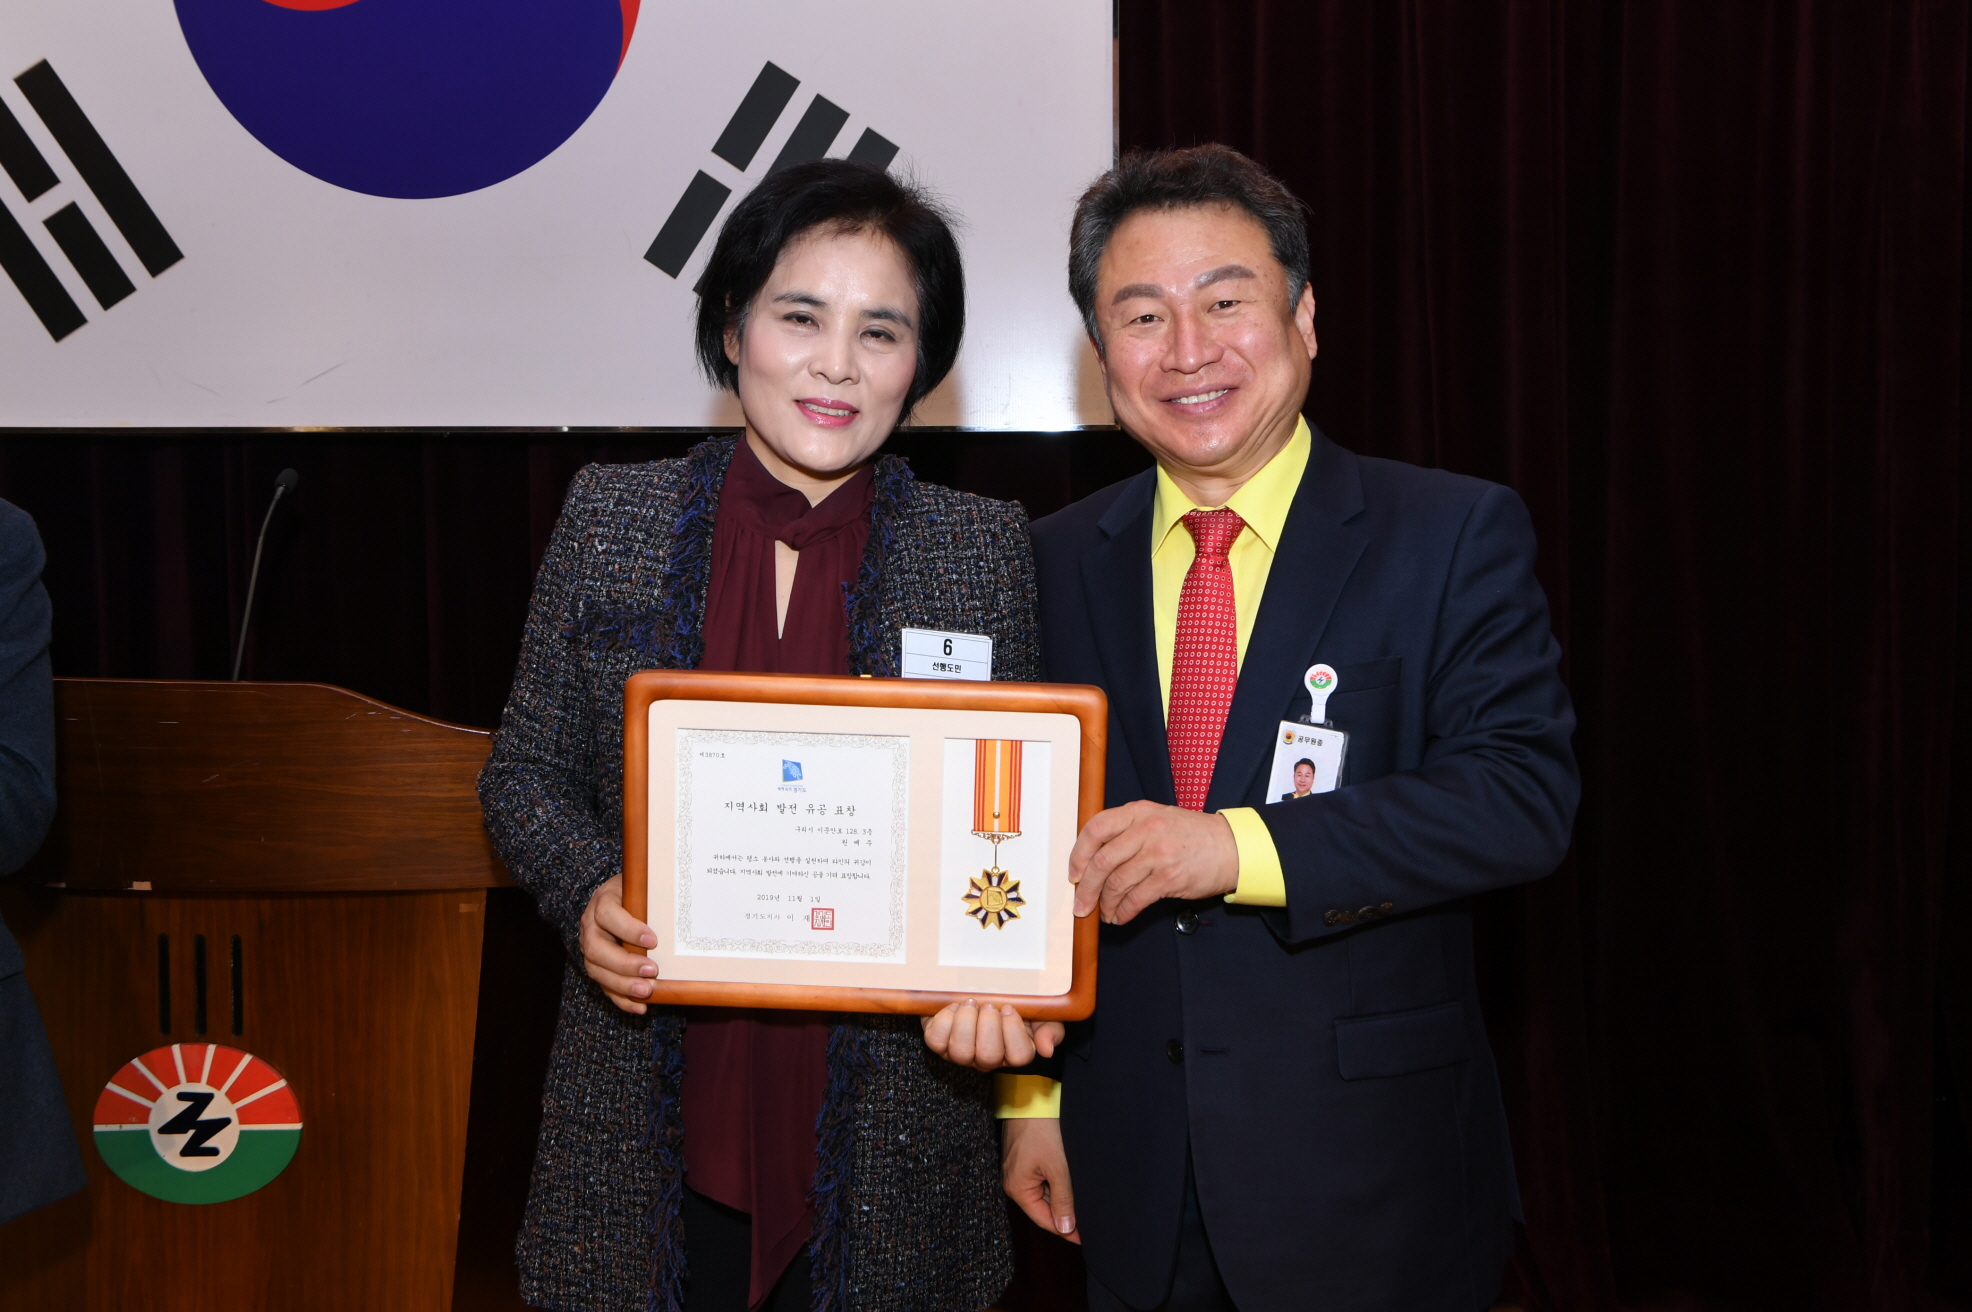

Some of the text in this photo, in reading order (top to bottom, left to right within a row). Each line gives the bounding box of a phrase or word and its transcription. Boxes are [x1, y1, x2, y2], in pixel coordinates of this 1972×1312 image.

[943, 638, 953, 656] 6
[932, 661, 962, 674] 선행도민
[1297, 735, 1323, 747] 공무원증
[724, 801, 857, 817] 지역사회 발전 유공 표창
[757, 894, 821, 904] 2019년 11월 1일
[744, 912, 781, 921] 경기도지사
